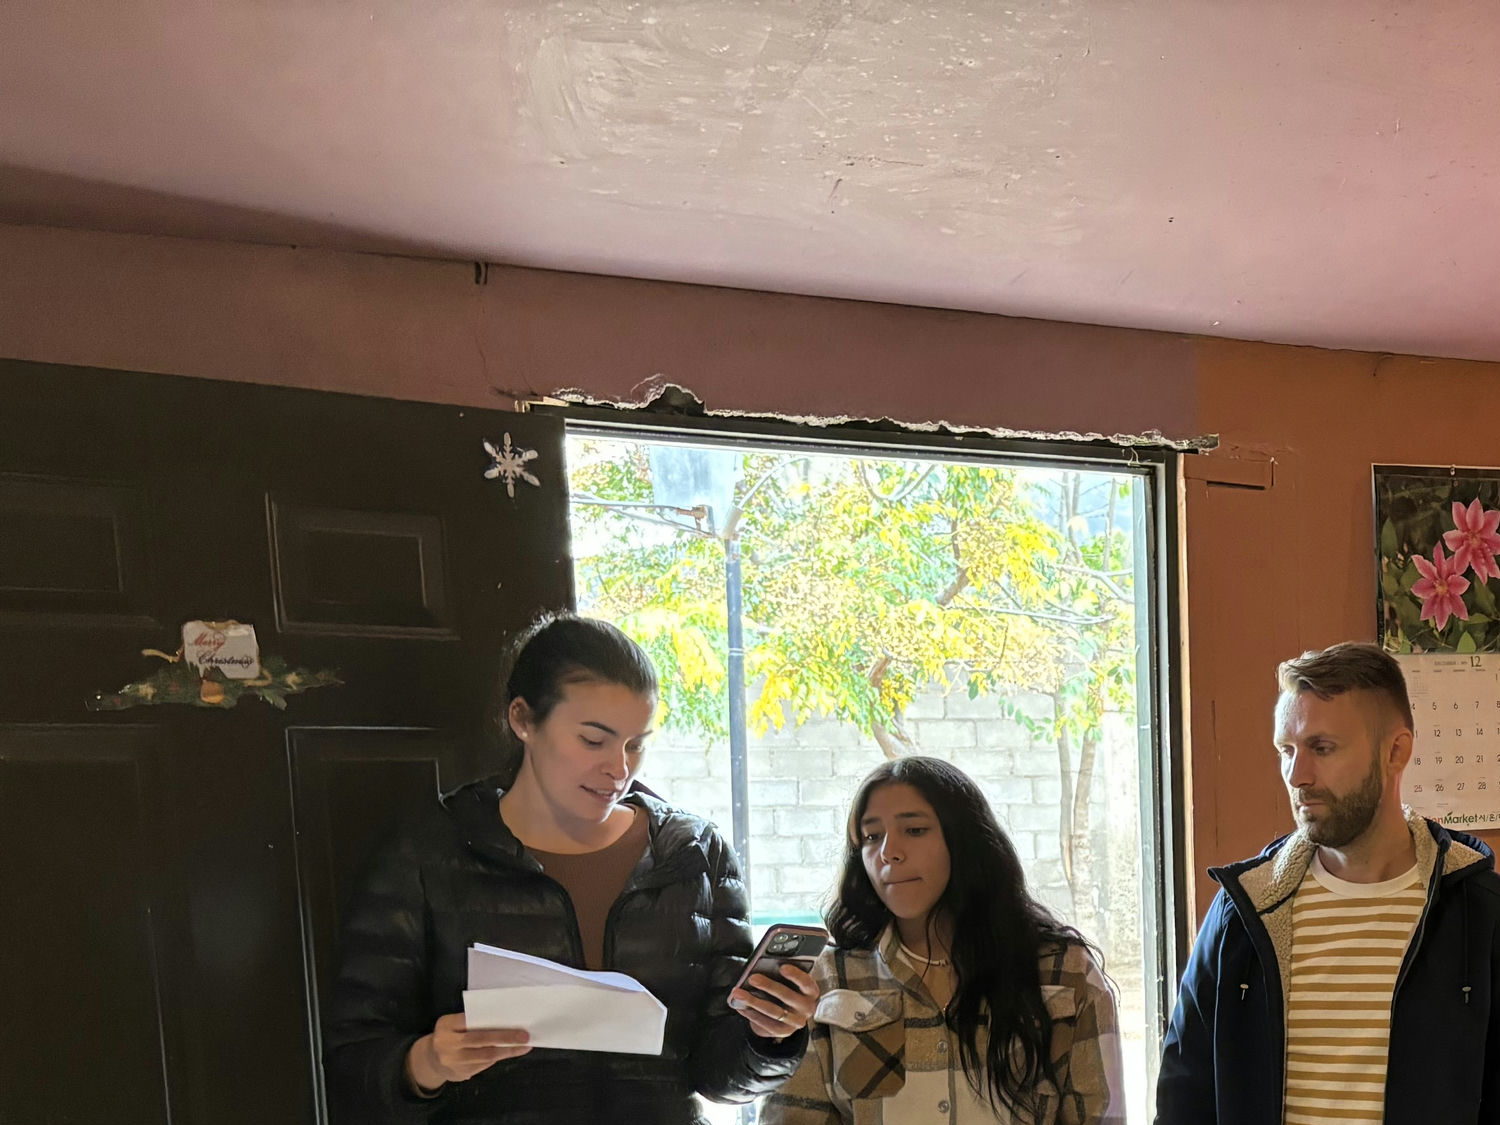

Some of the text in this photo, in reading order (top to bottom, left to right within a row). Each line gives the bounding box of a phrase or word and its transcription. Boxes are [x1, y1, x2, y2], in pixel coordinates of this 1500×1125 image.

[1470, 655, 1482, 668] 12
[1432, 702, 1437, 710] 5
[1453, 702, 1459, 710] 6
[1475, 700, 1480, 709] 7
[1434, 729, 1441, 737] 12
[1455, 728, 1462, 736] 13
[1476, 727, 1484, 735] 14
[1414, 757, 1422, 766] 18
[1435, 756, 1443, 764] 19
[1455, 755, 1464, 764] 20
[1476, 755, 1484, 763] 21
[1414, 784, 1423, 793] 25
[1435, 783, 1445, 792] 26
[1456, 783, 1465, 791] 27
[1477, 782, 1487, 790] 28
